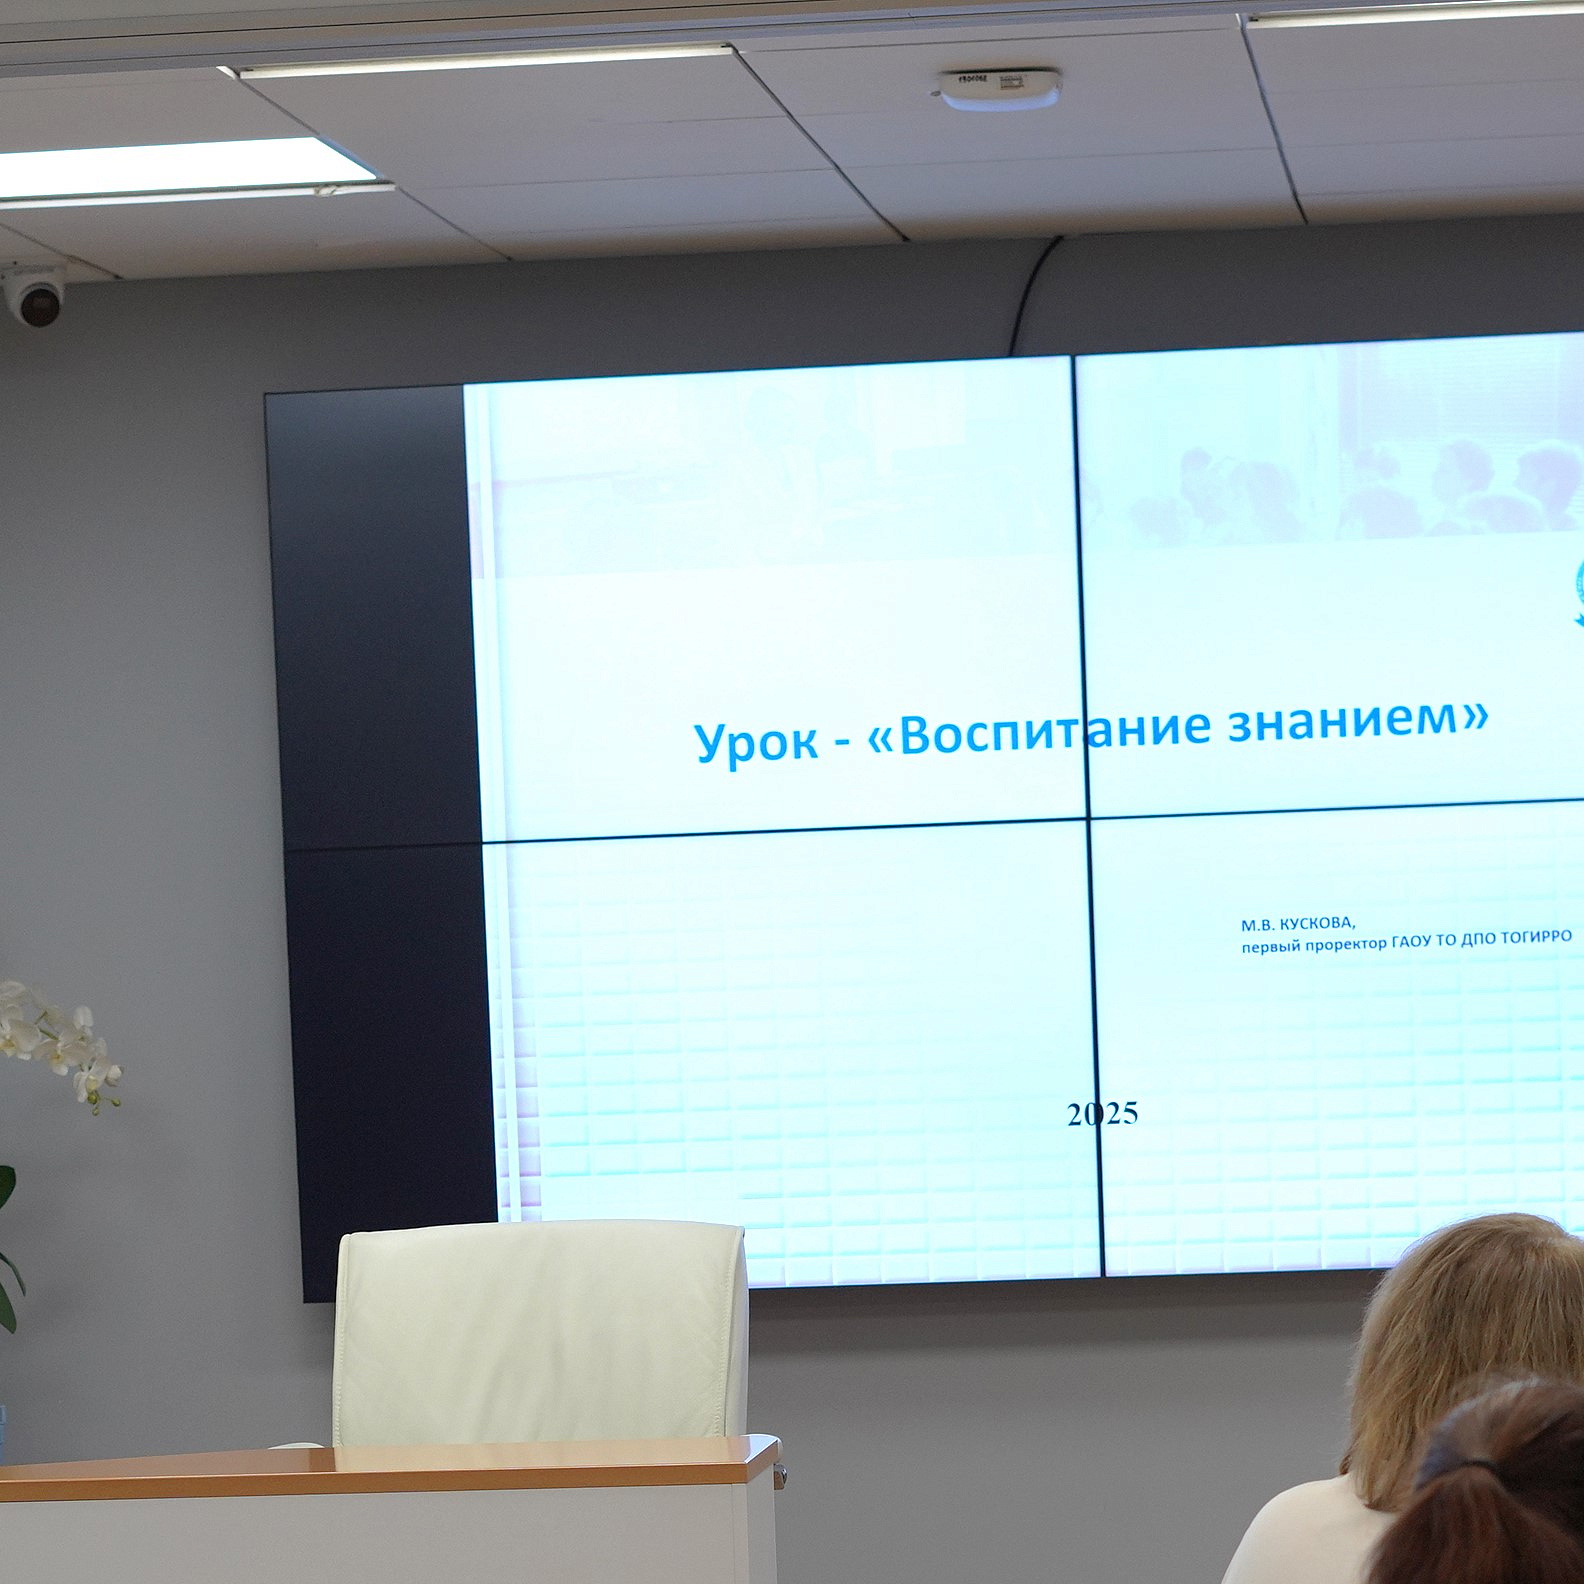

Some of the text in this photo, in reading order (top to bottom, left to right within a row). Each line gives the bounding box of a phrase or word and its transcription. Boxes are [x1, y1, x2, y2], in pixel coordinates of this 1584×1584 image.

[694, 724, 818, 772] Урок
[868, 714, 1210, 754] «Воспитание
[1229, 704, 1488, 742] знанием»
[1242, 916, 1355, 931] М.В. КУСКОВА,
[1243, 930, 1572, 955] первый проректор ГАОУ ТО ДПО ТОГИРРО
[1067, 1102, 1138, 1126] 2025
